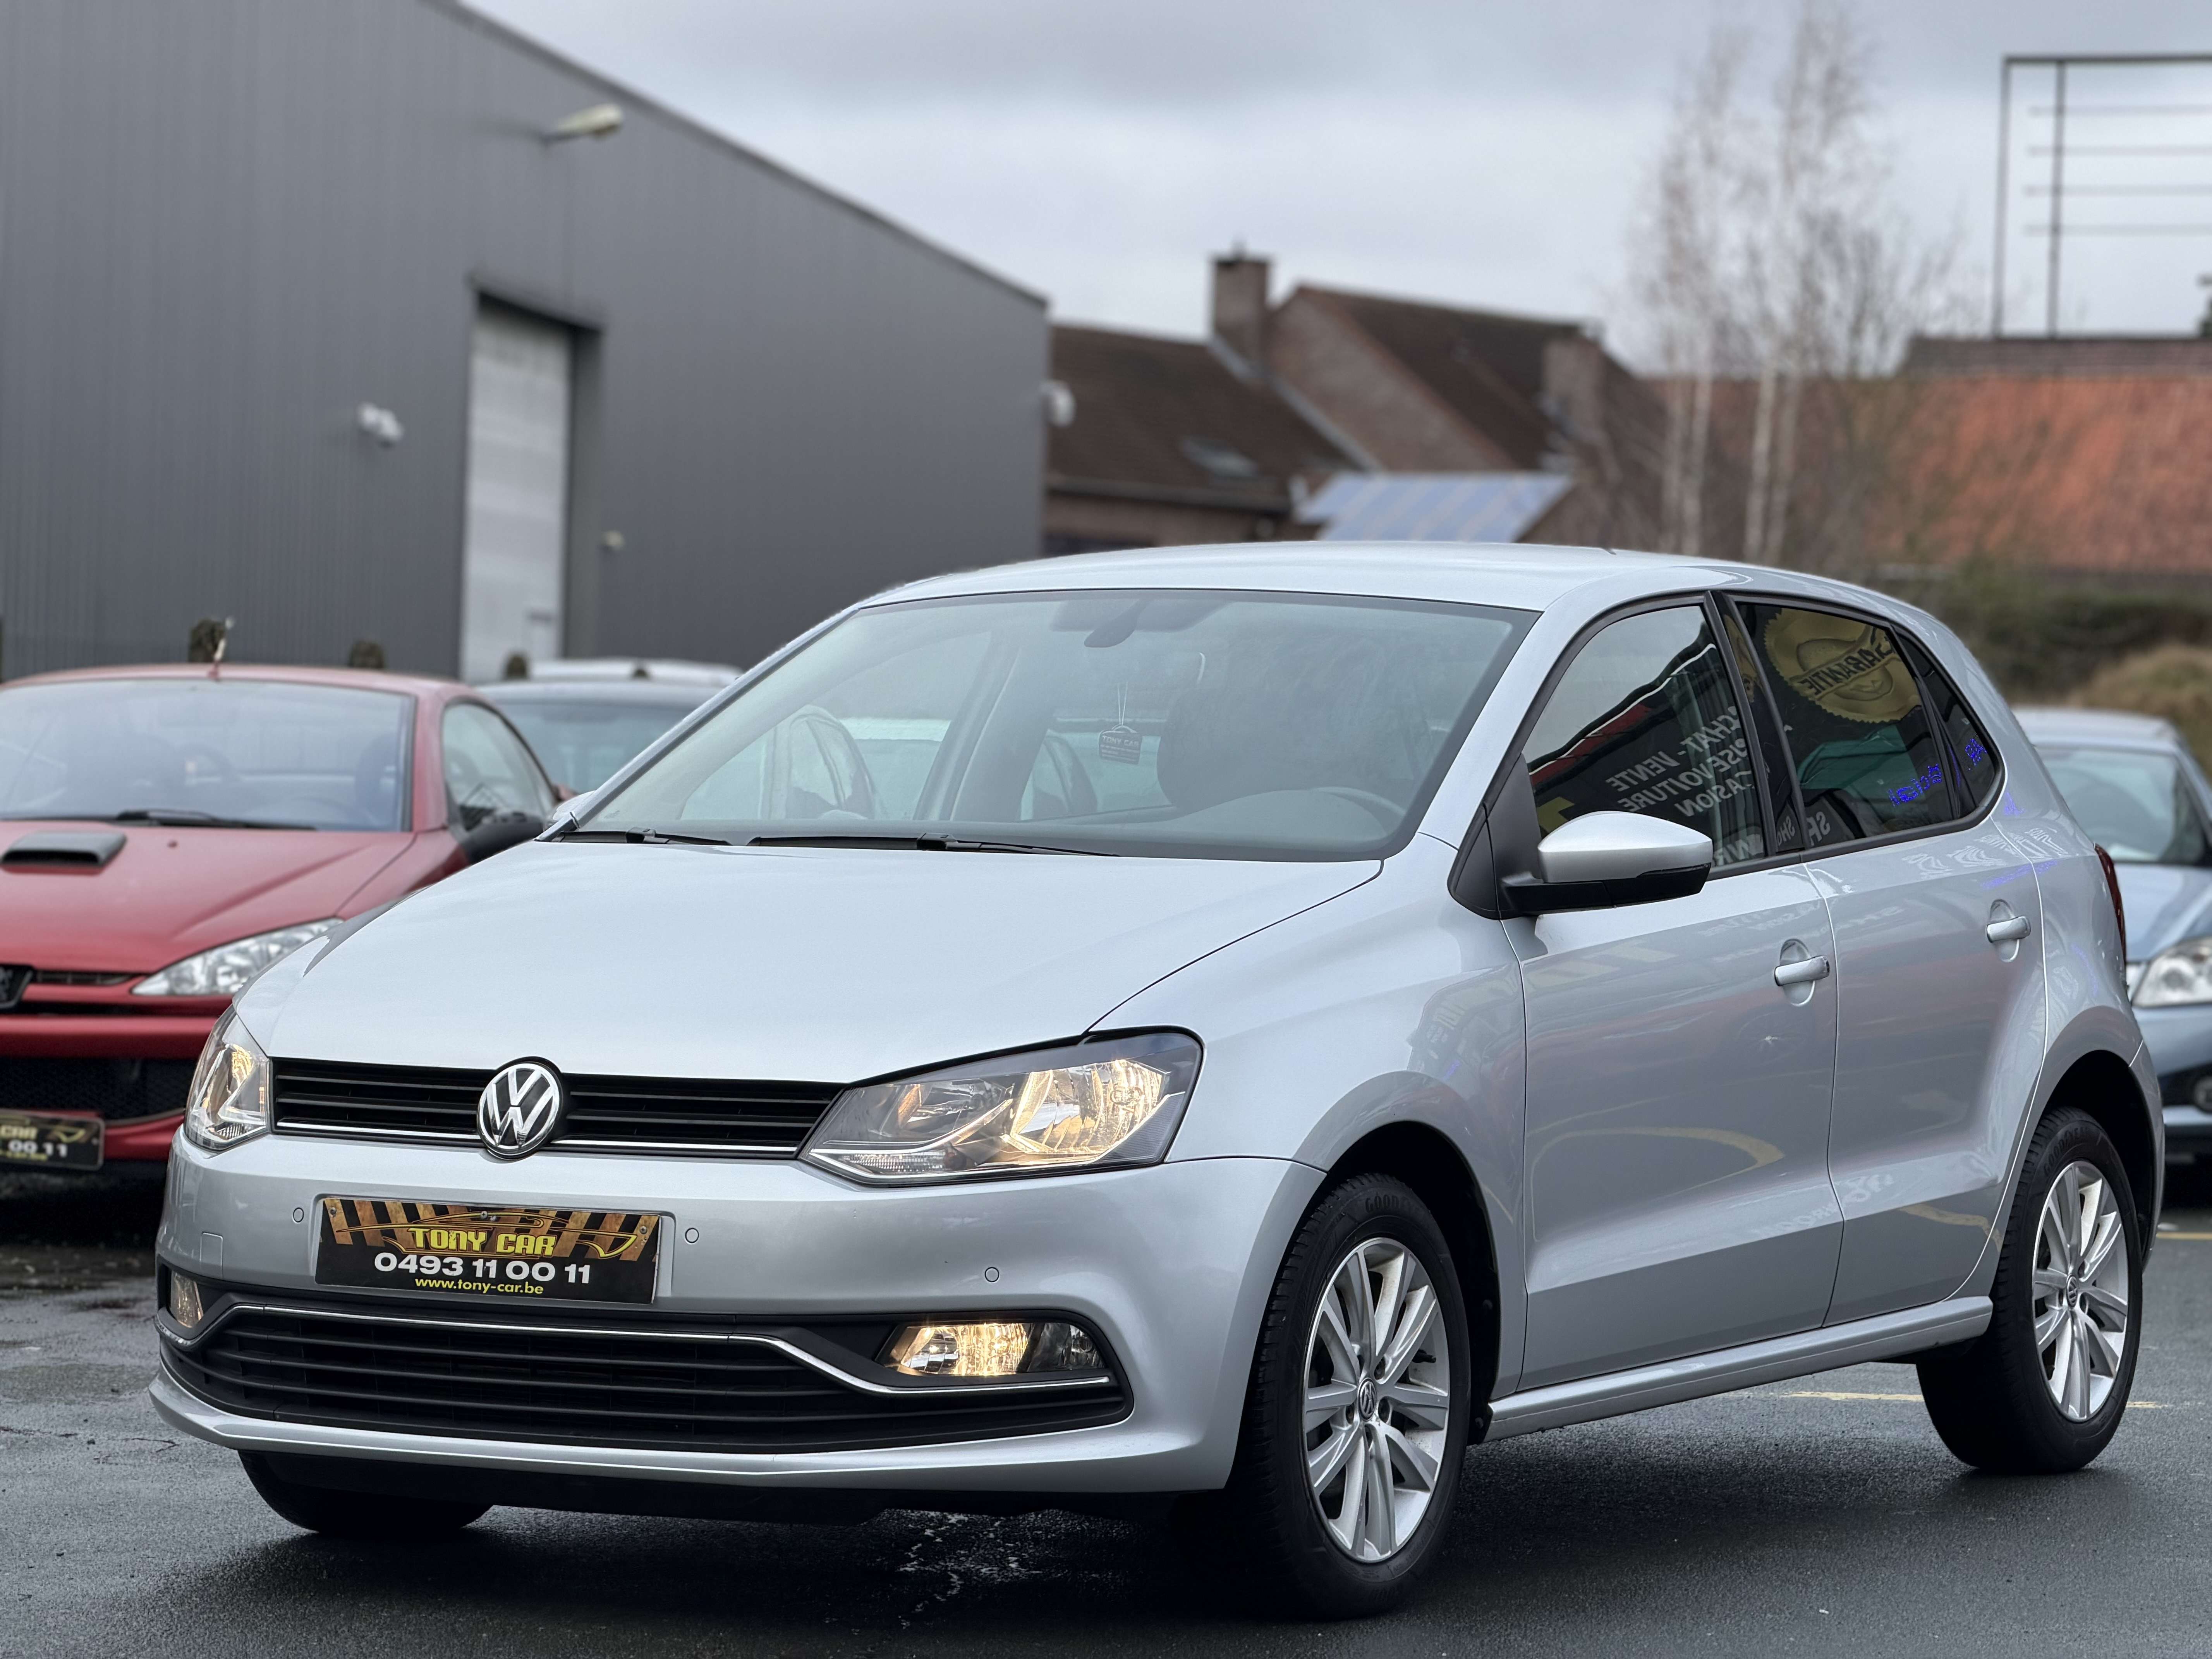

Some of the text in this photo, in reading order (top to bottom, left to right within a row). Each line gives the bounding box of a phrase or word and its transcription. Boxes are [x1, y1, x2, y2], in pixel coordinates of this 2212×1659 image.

[1102, 735, 1122, 744] TONY
[408, 1227, 556, 1256] TONY CAR
[374, 1252, 590, 1283] 0493 11 00 11
[415, 1278, 544, 1294] www.tony-car.be
